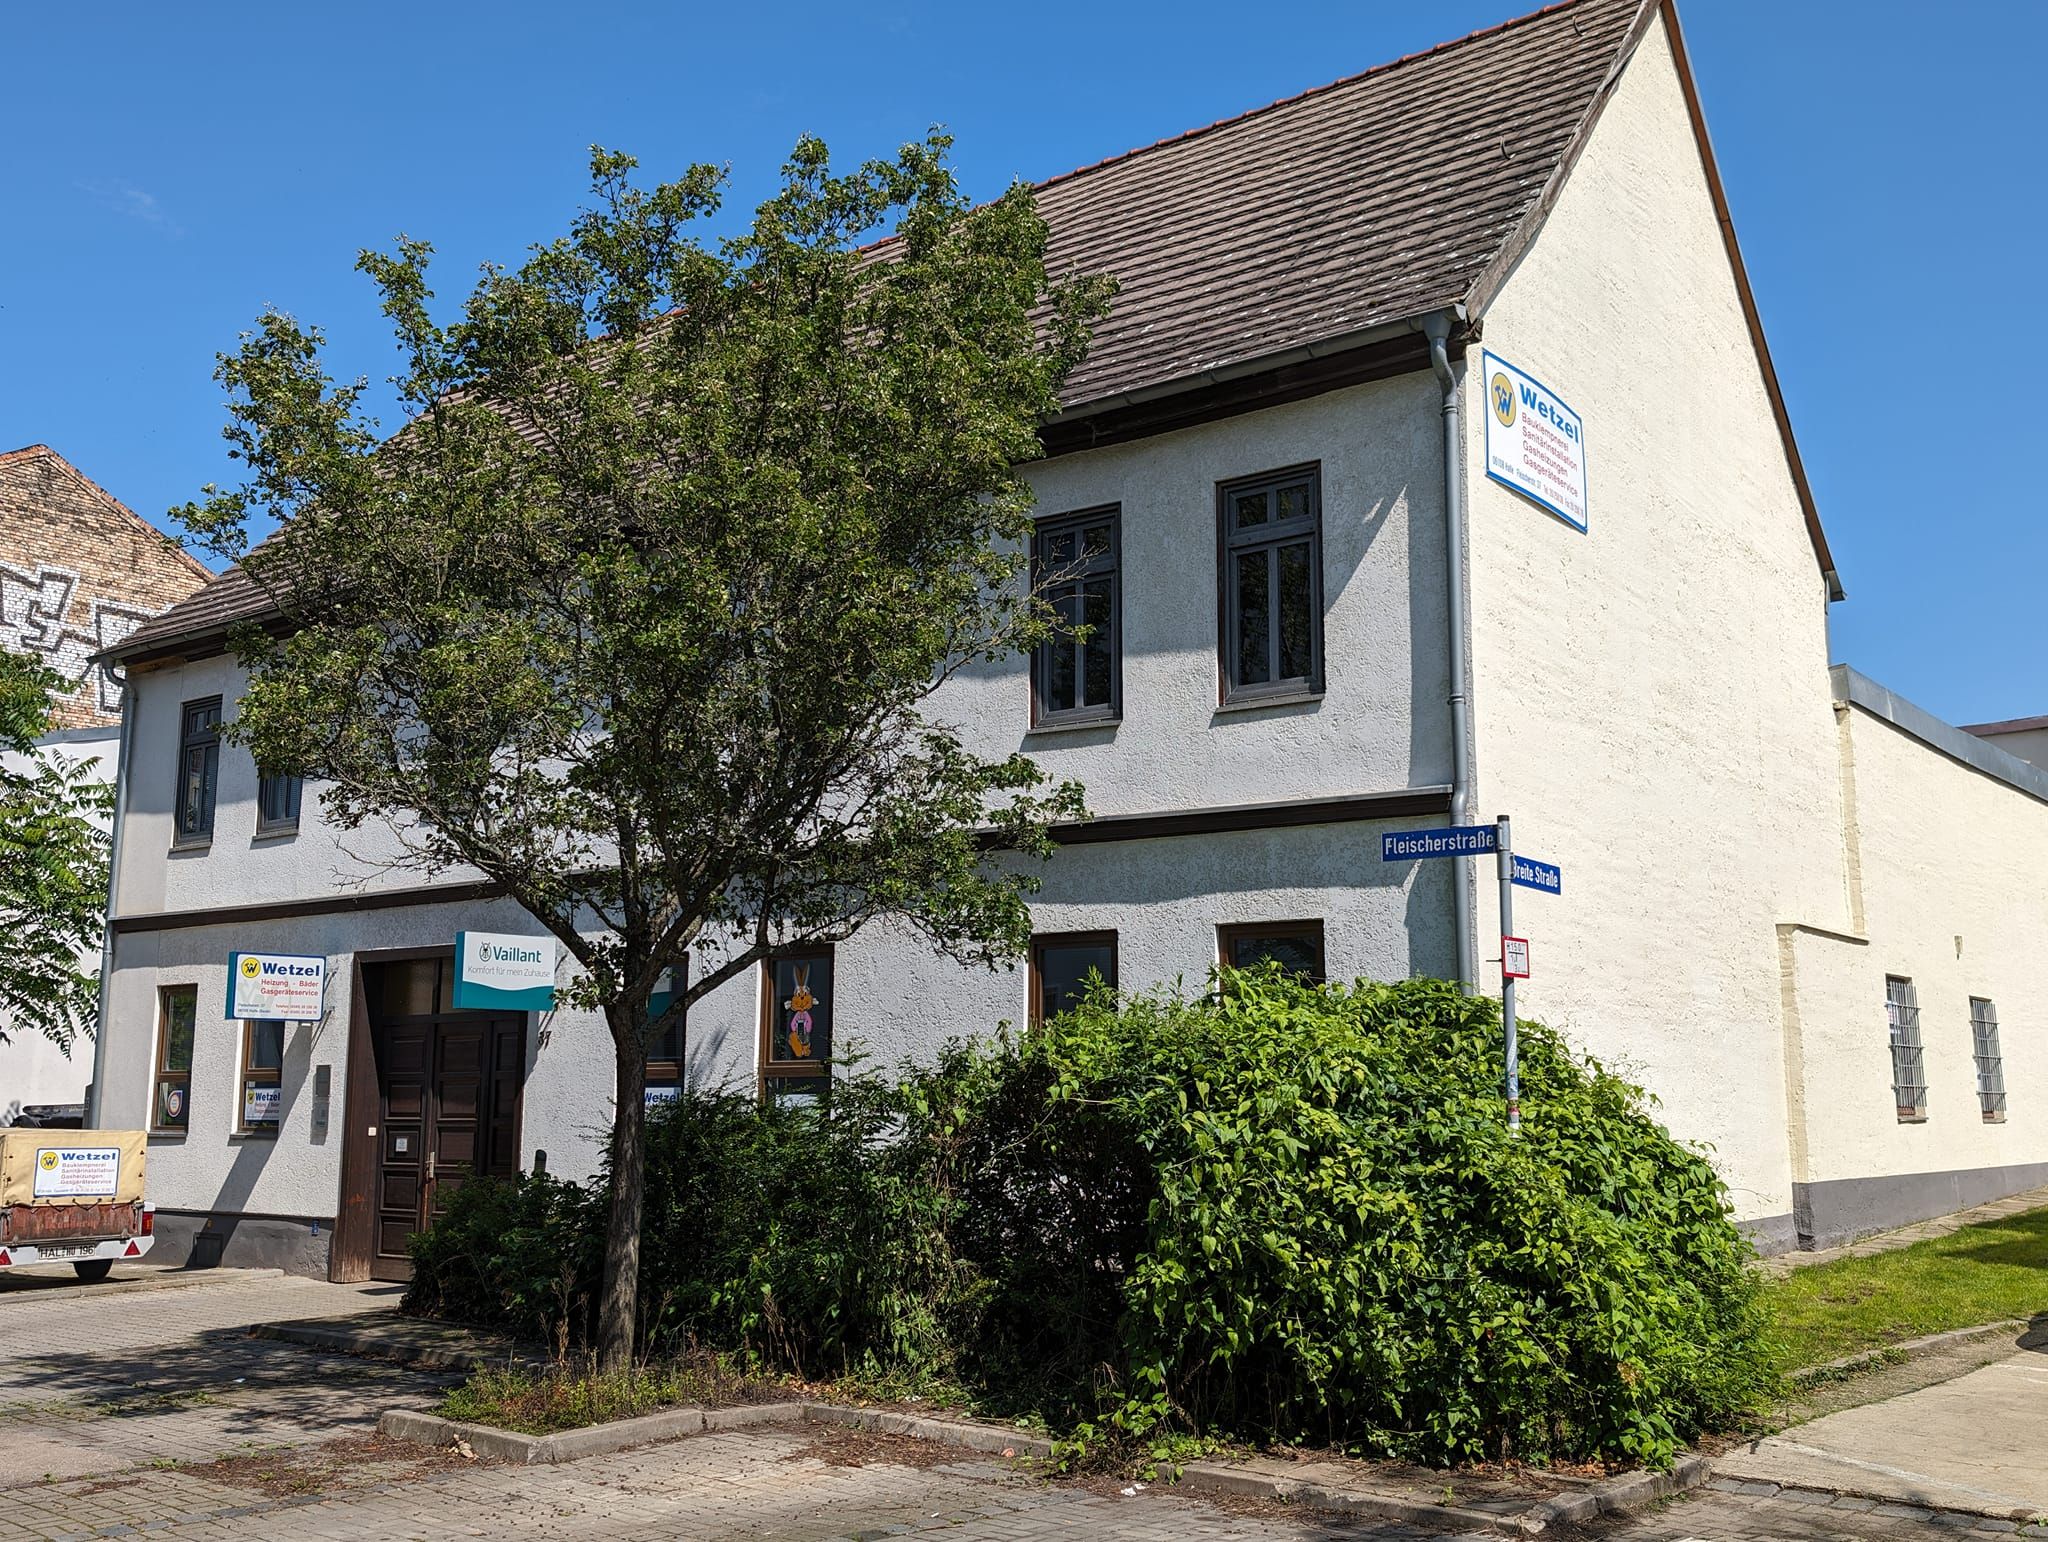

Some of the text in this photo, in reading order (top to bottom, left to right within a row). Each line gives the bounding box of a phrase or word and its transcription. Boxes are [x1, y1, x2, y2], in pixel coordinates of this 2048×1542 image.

[1519, 381, 1579, 444] Wetzel
[1521, 411, 1569, 452] Bauklempnerei
[1522, 425, 1578, 472] Sanitärinstallation
[1522, 440, 1569, 477] Gasheizungen
[1523, 453, 1579, 498] Gasgeräteservice
[1384, 830, 1495, 855] Fleischerstraße
[1534, 865, 1559, 888] Straße
[493, 945, 542, 963] Vaillant
[262, 962, 320, 977] Wetzel
[467, 964, 551, 978] Komfort für mein Zuhause
[260, 979, 289, 987] Heizung
[298, 980, 319, 988] Bäder
[260, 987, 319, 996] Gasgeräteservice
[255, 1092, 281, 1101] Wetzel
[645, 1092, 680, 1103] Wetzel
[61, 1152, 116, 1161] Wetzel
[40, 1247, 61, 1258] HAL
[79, 1245, 94, 1255] 196
